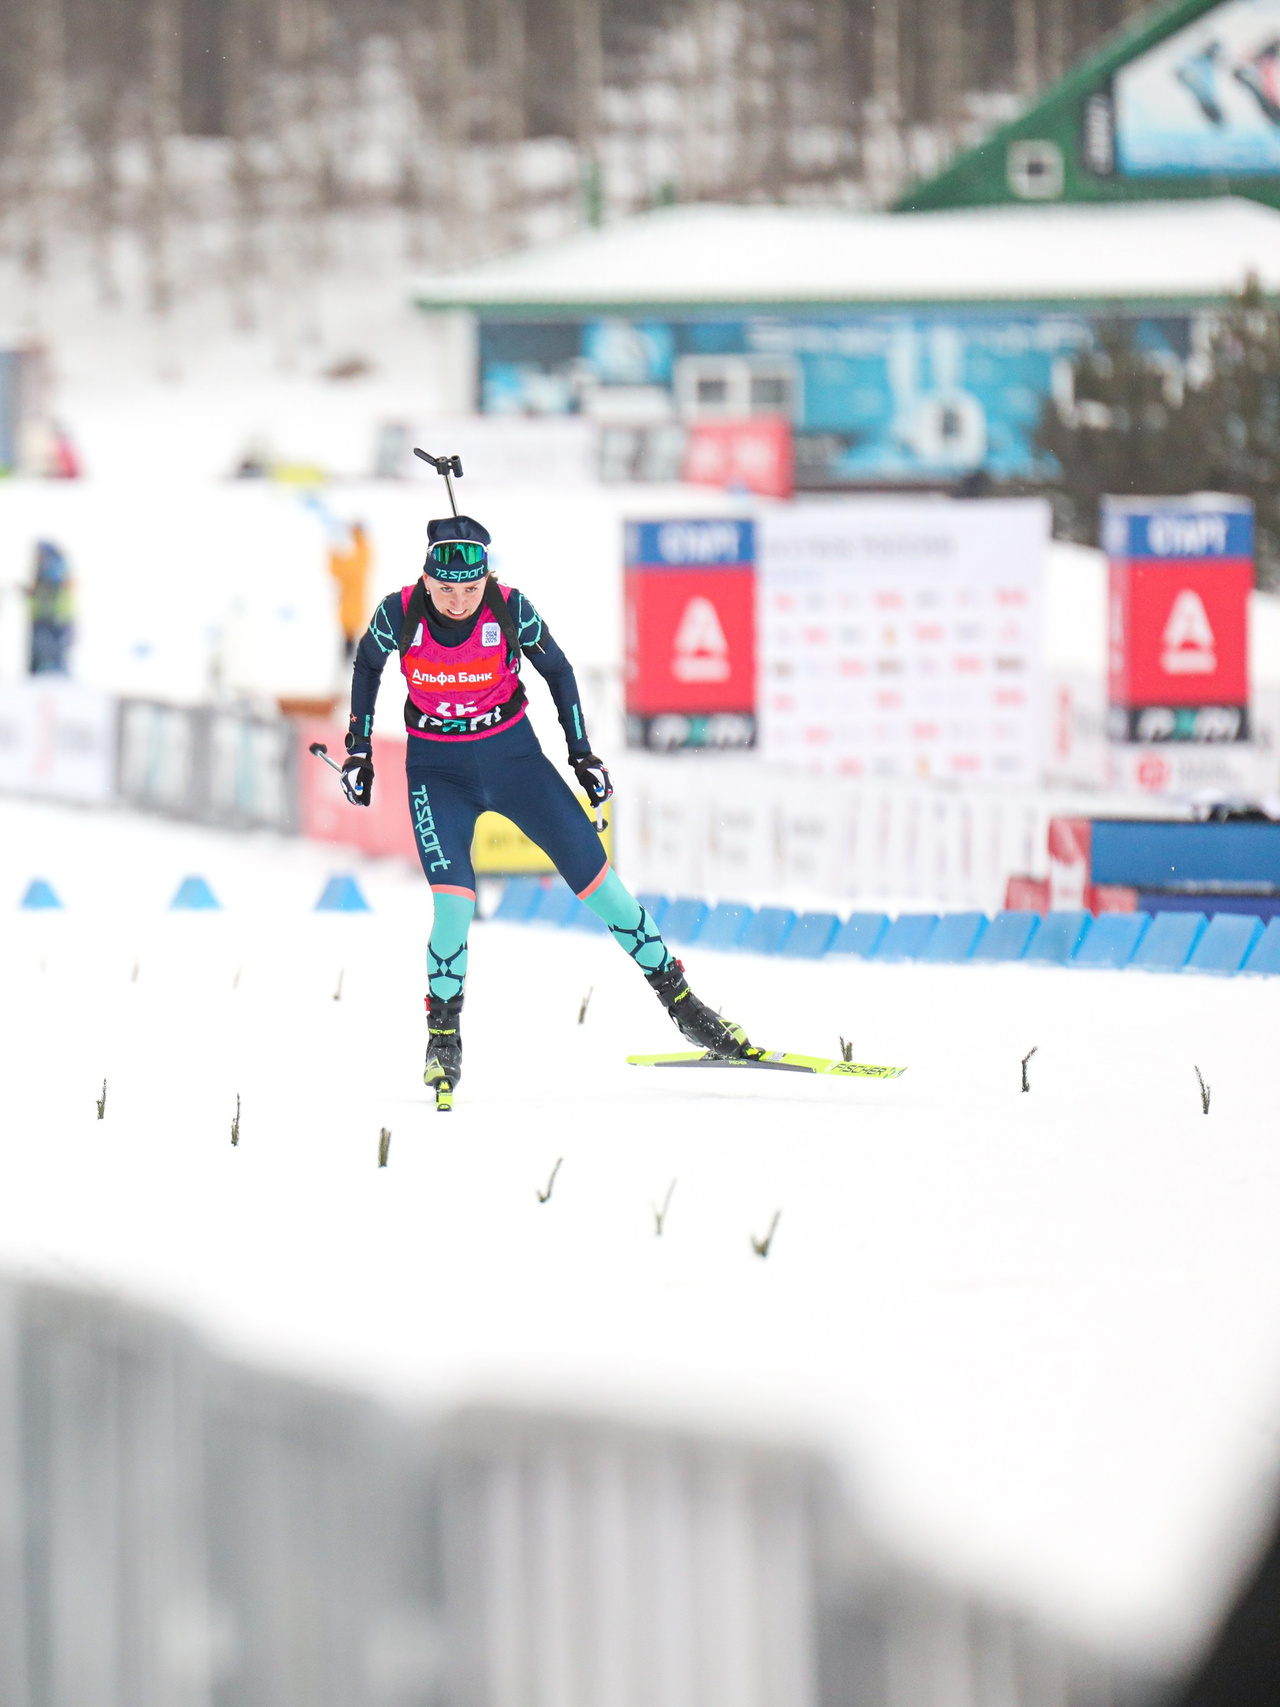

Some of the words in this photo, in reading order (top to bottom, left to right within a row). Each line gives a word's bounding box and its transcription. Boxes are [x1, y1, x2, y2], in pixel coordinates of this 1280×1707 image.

[412, 668, 456, 685] Альфа
[458, 671, 493, 683] Банк
[830, 1062, 888, 1077] FISCHER
